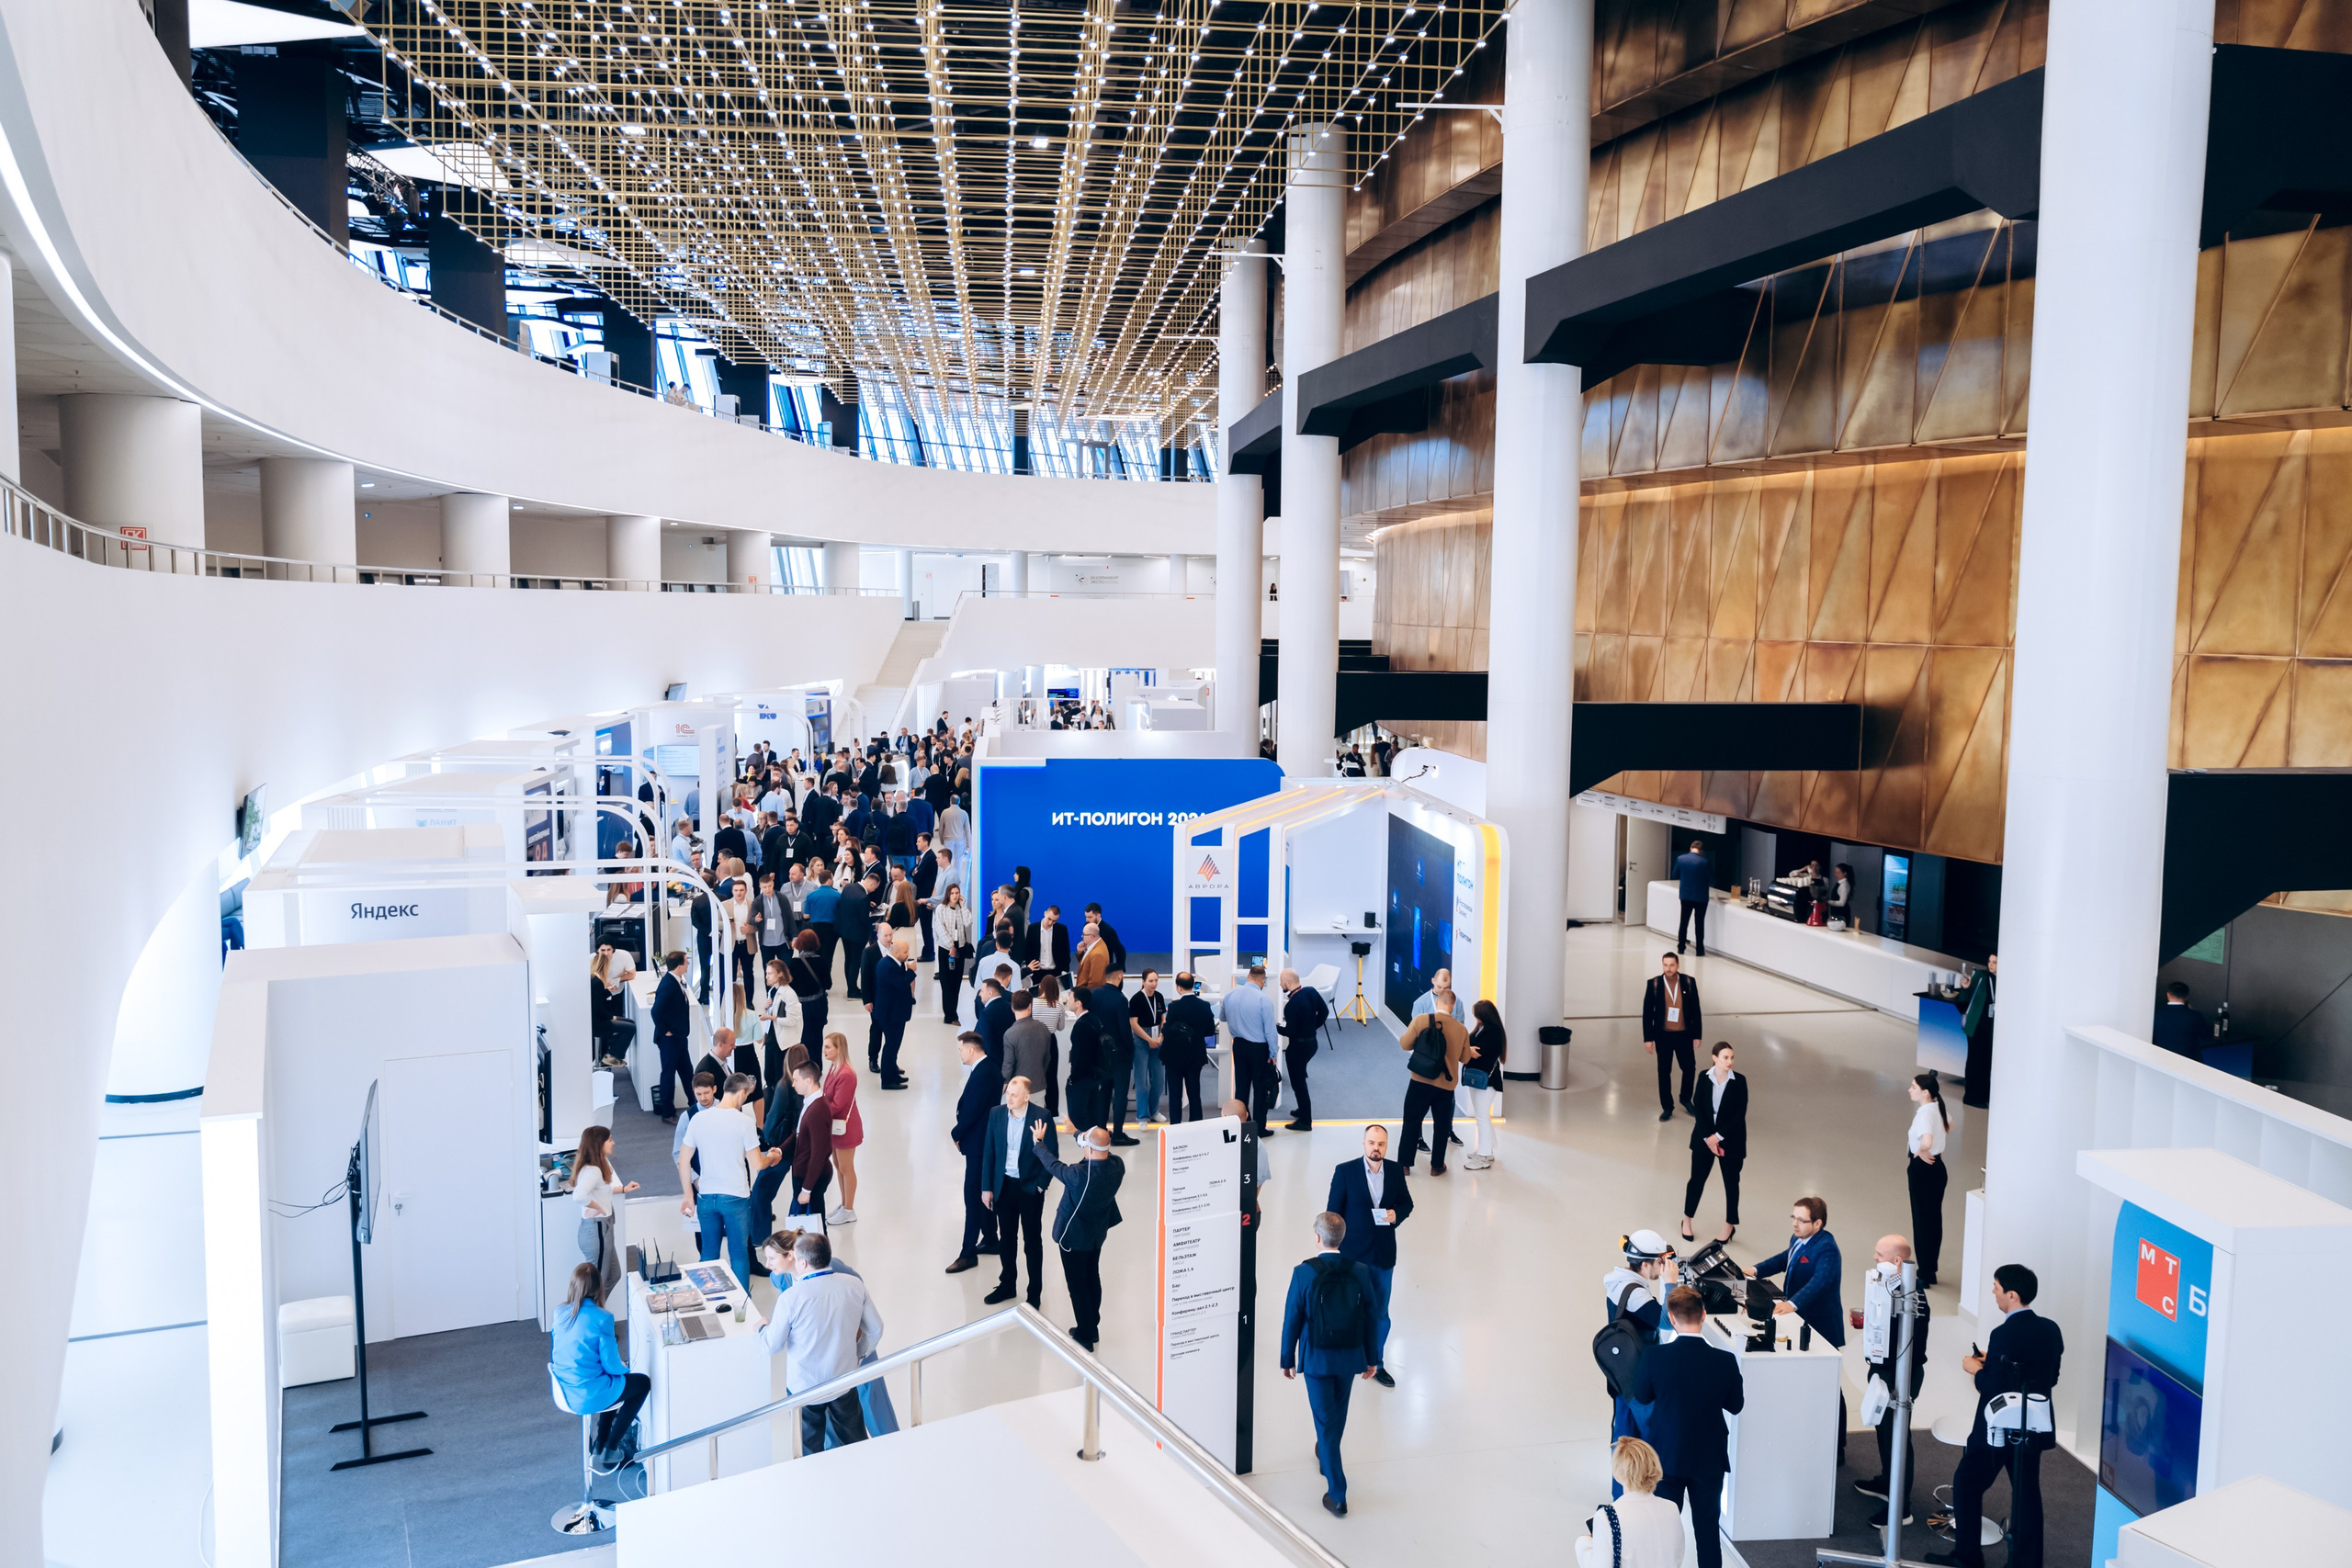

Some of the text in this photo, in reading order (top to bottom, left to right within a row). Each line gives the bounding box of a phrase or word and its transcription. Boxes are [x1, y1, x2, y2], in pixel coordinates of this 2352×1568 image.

[1052, 812, 1205, 826] ИТ-ПОЛИГОН 202
[351, 903, 419, 920] Яндекс
[1244, 1134, 1251, 1144] 4
[1244, 1174, 1251, 1184] 3
[1242, 1214, 1251, 1226] 2
[1173, 1238, 1201, 1247] АМФИТЕАТР
[1172, 1252, 1197, 1261] БЕЛЬЭТАЖ
[2141, 1243, 2207, 1317] МТС Б
[1243, 1314, 1248, 1324] 1
